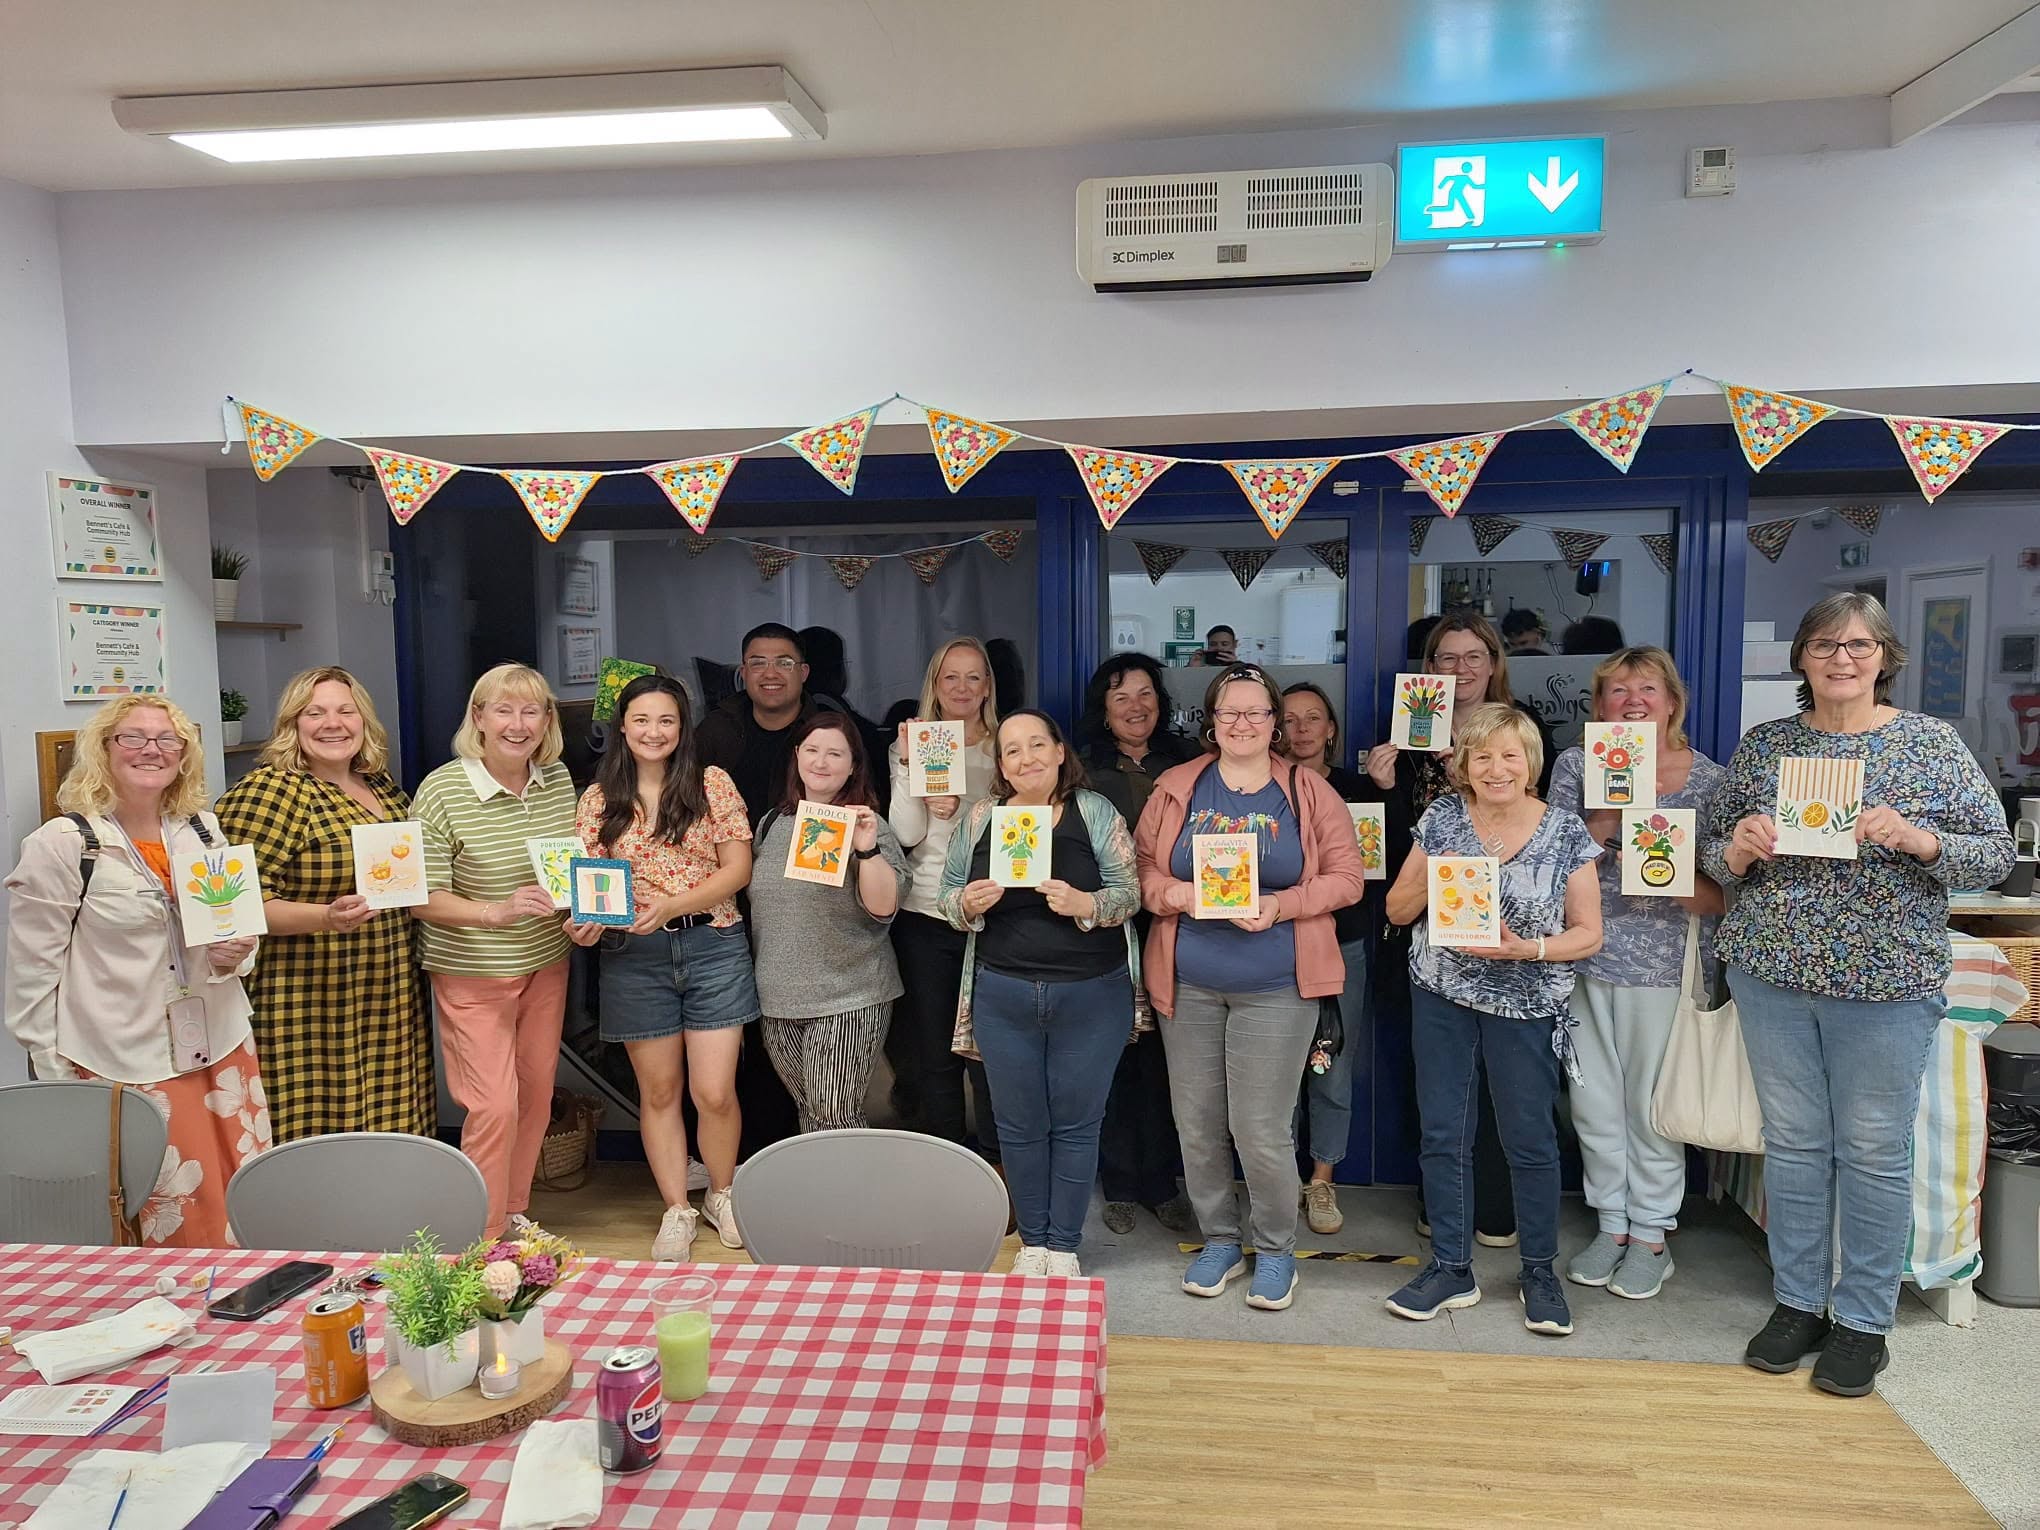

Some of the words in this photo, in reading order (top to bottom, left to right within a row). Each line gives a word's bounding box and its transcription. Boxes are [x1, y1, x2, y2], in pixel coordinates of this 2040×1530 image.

[1126, 250, 1175, 263] Dimplex
[80, 498, 107, 507] OVERALL
[108, 501, 131, 509] WINNER
[87, 527, 119, 536] Community
[805, 806, 814, 814] IL
[817, 808, 848, 820] DOLCE
